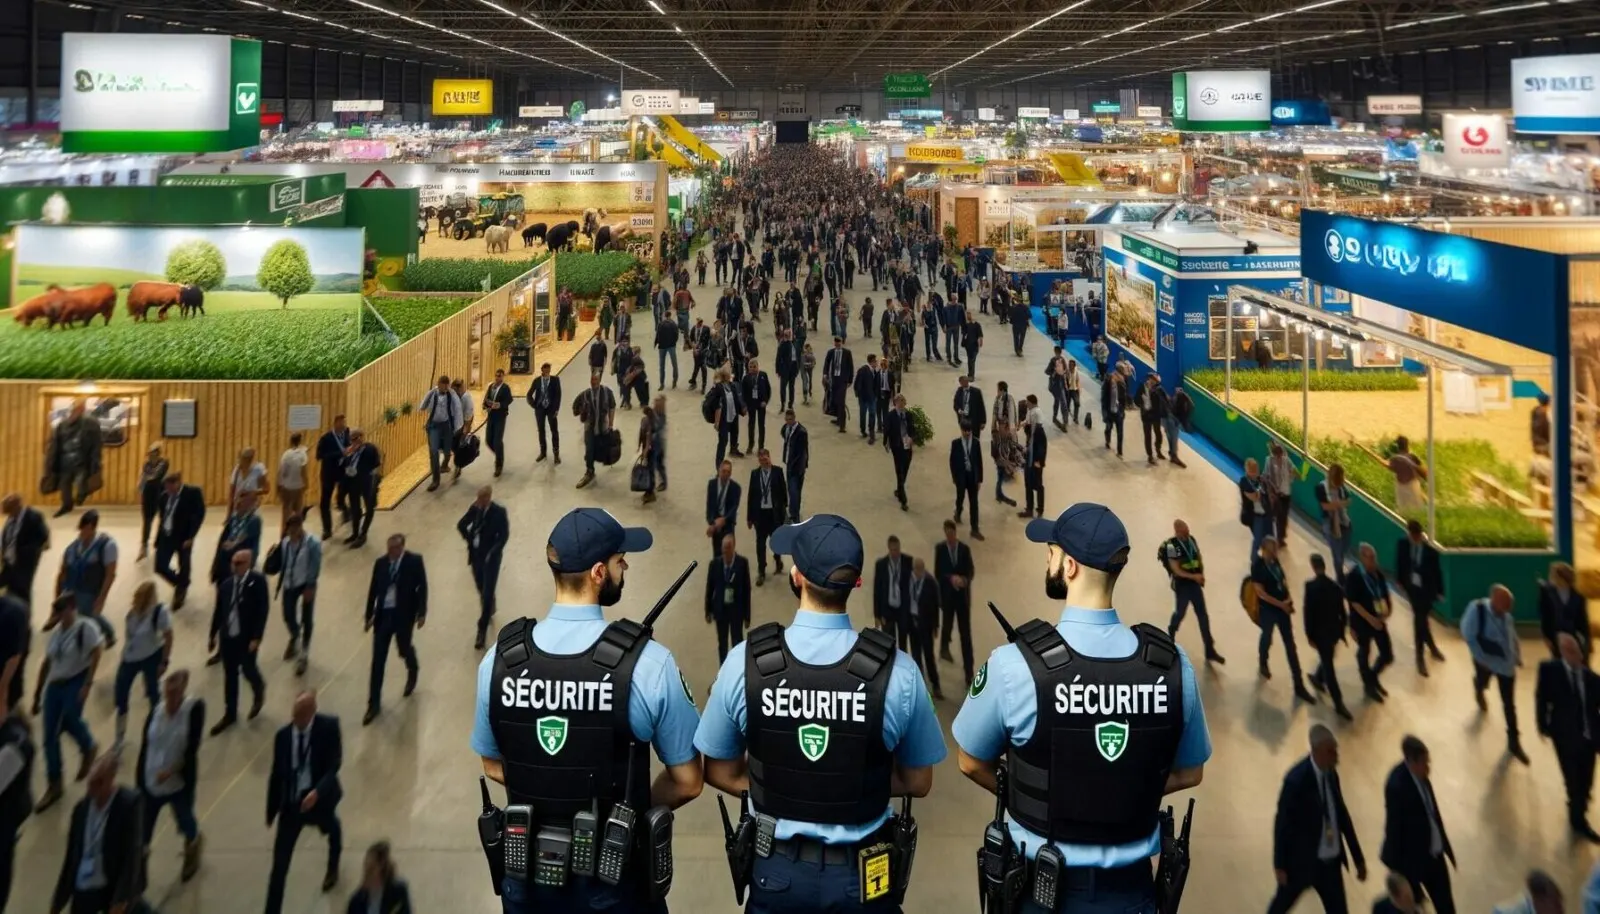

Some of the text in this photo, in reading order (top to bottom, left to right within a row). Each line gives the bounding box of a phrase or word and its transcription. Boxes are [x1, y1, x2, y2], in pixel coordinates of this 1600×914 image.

[501, 669, 613, 711] SÉCURITÉ
[761, 678, 867, 722] SÉCURITÉ
[1054, 674, 1168, 715] SÉCURITÉ
